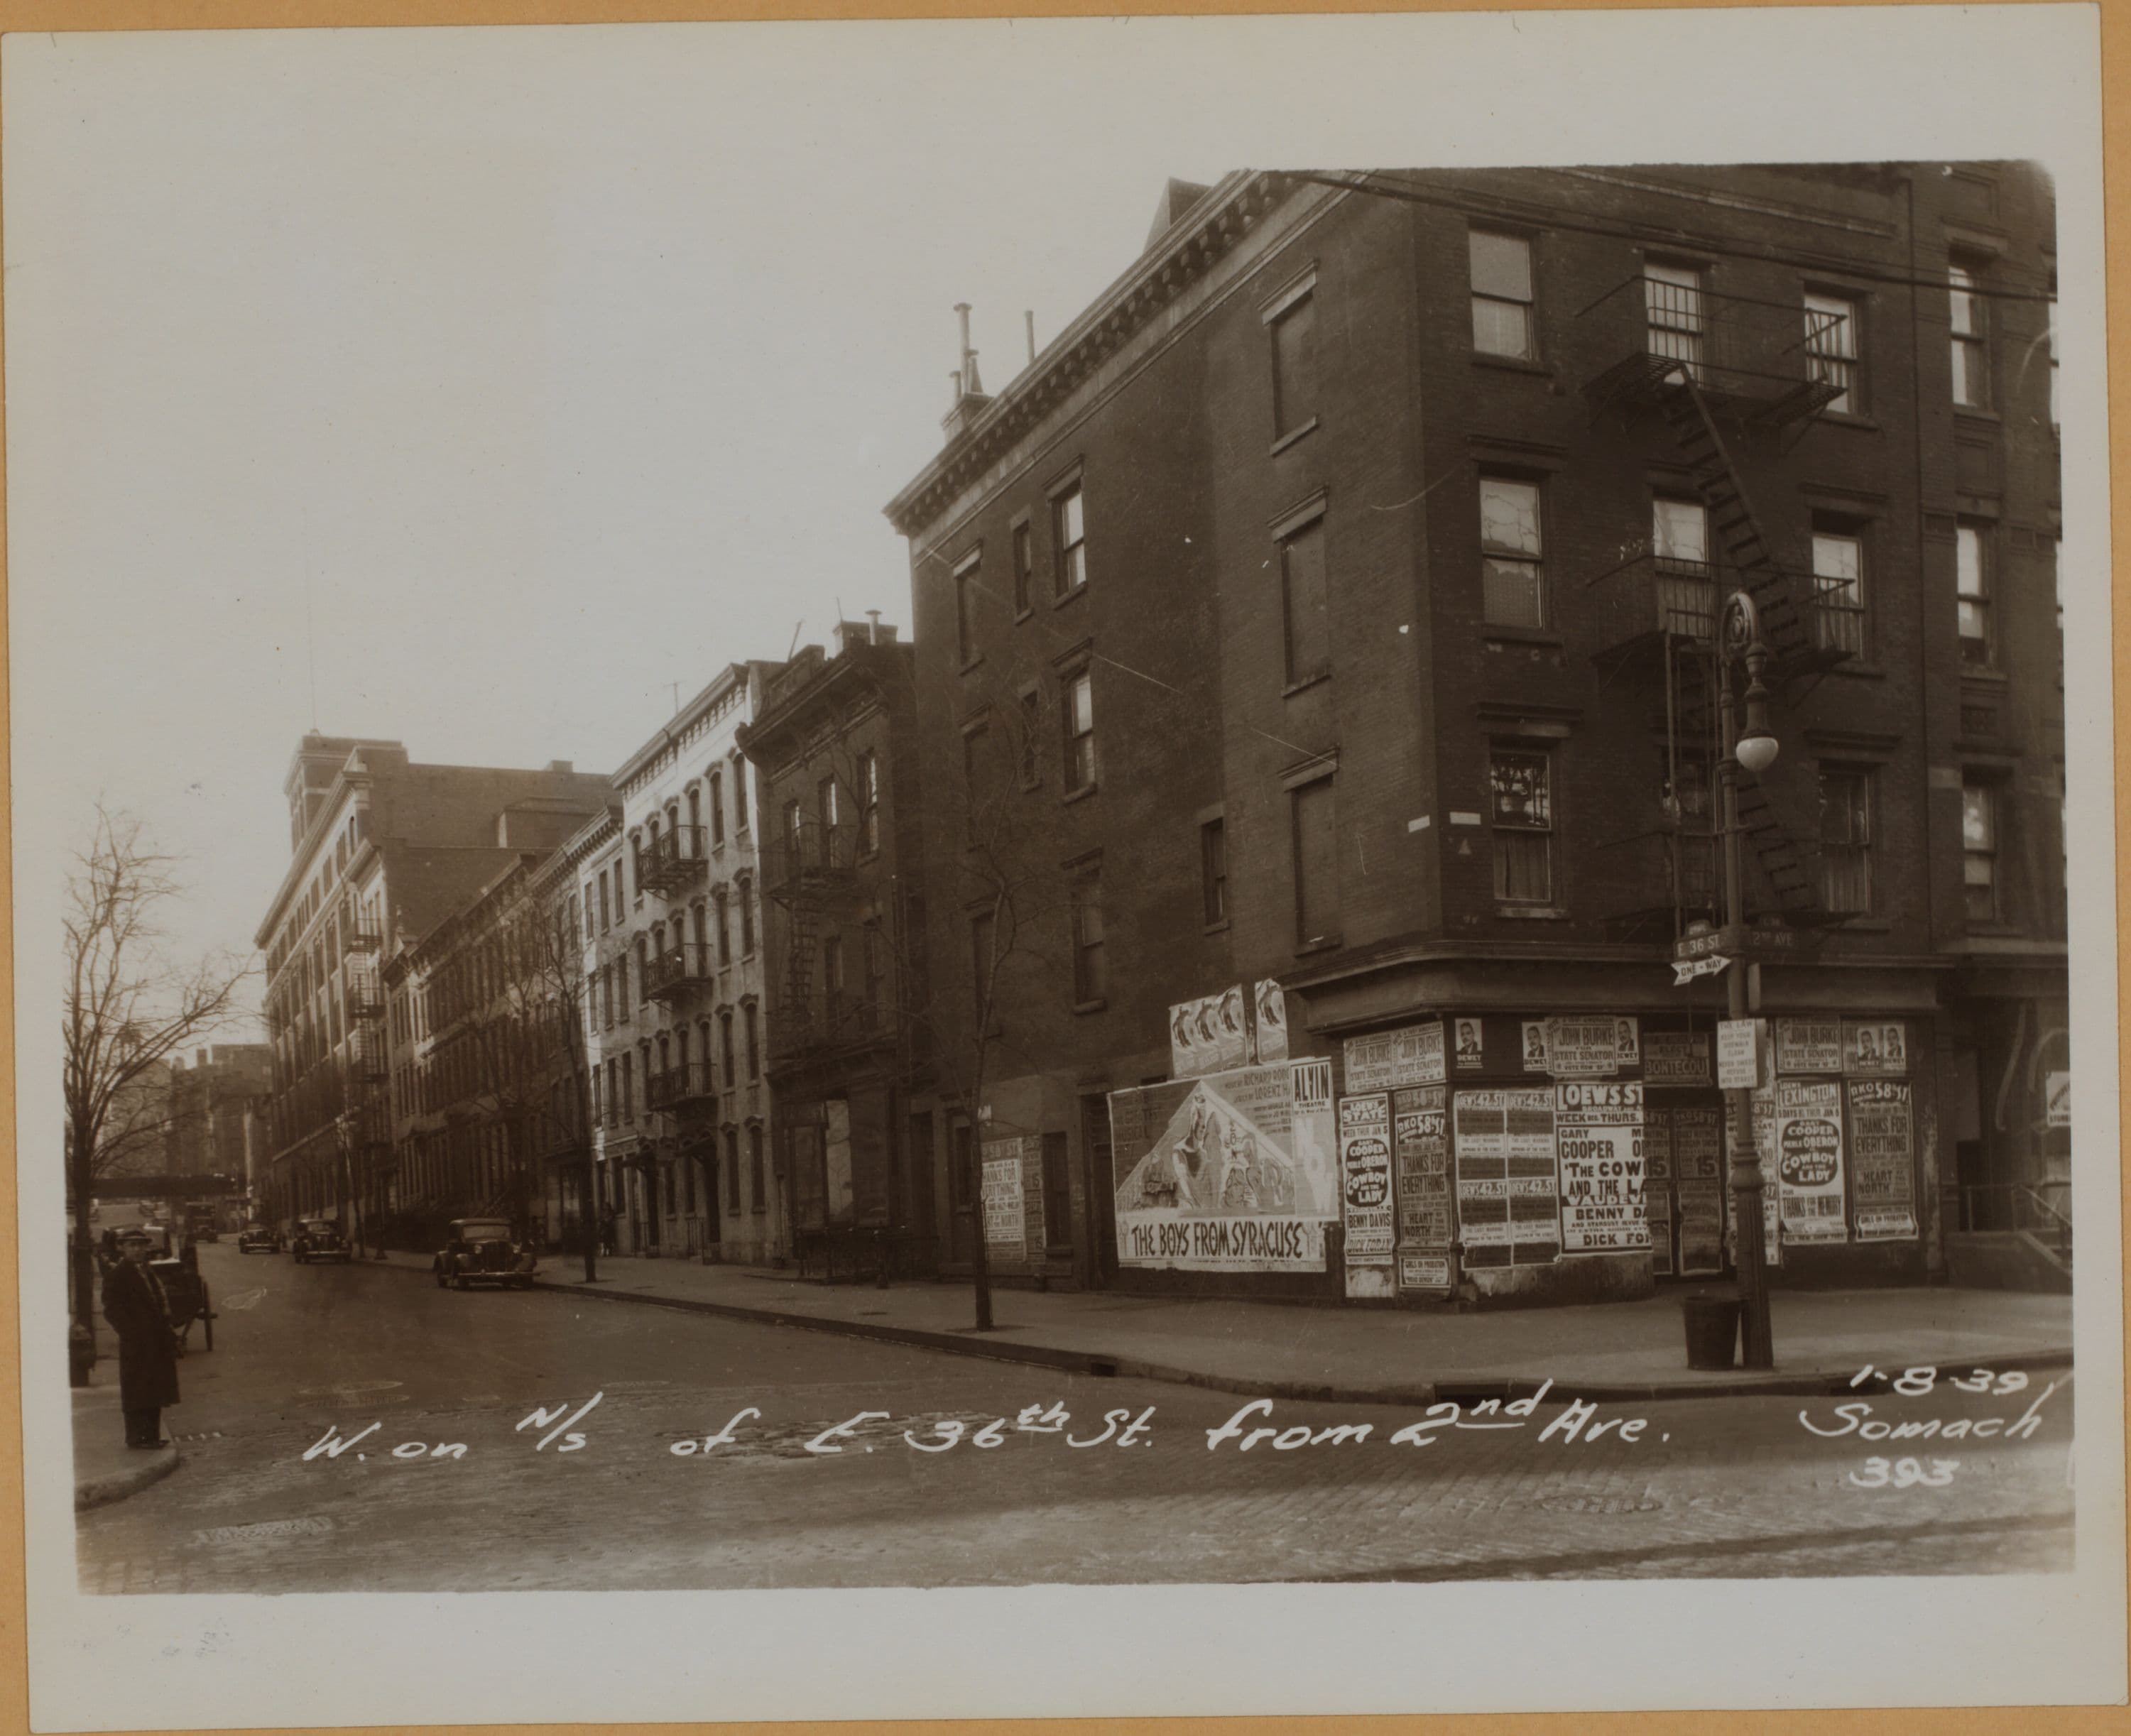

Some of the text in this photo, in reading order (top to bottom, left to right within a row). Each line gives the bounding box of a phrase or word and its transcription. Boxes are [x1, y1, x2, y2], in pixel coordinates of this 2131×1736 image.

[1775, 931, 1794, 946] AVE
[1677, 942, 1686, 958] E
[1689, 938, 1704, 954] 36
[1705, 959, 1723, 972] WAY
[1557, 1027, 1612, 1047] JOHN BURKE
[1810, 1026, 1838, 1045] BURKE
[1554, 1051, 1612, 1061] STATE SENATOR
[1783, 1050, 1838, 1059] STATE SENATOR
[1645, 1060, 1706, 1075] BONTECOU
[1295, 1064, 1330, 1102] ALVIN
[1850, 1083, 1875, 1098] RKO
[1477, 1093, 1493, 1107] 42
[1527, 1093, 1541, 1107] 42
[1779, 1083, 1838, 1108] LEXINGTON
[1343, 1104, 1387, 1122] STATE
[1556, 1113, 1586, 1123] WEEK
[1397, 1117, 1417, 1135] RKO
[1788, 1125, 1834, 1136] COOPER
[1855, 1115, 1908, 1135] THANKS FOR
[1562, 1130, 1590, 1139] GARY
[1803, 1135, 1838, 1149] OBERON
[1350, 1144, 1385, 1157] COOPER
[1562, 1140, 1615, 1159] COOPER
[1855, 1135, 1907, 1154] EVERYTHING
[1404, 1154, 1429, 1175] THANKS
[1429, 1152, 1445, 1173] FOR
[1782, 1152, 1836, 1174] COWBOY
[1798, 1169, 1831, 1183] LADY
[1346, 1172, 1386, 1196] COWBOY
[1402, 1175, 1445, 1195] EVERYTHING
[1479, 1182, 1493, 1195] 42
[1529, 1179, 1543, 1194] 42
[1569, 1179, 1591, 1196] AND
[1597, 1179, 1620, 1195] THE
[1358, 1189, 1385, 1203] LADY
[1575, 1207, 1624, 1221] BENNY
[1782, 1196, 1806, 1219] THANKS
[1348, 1213, 1391, 1229] BENNY DAVIS
[1131, 1221, 1304, 1259] THE BOYS FROM SYRACUSE
[1582, 1233, 1619, 1245] DICK
